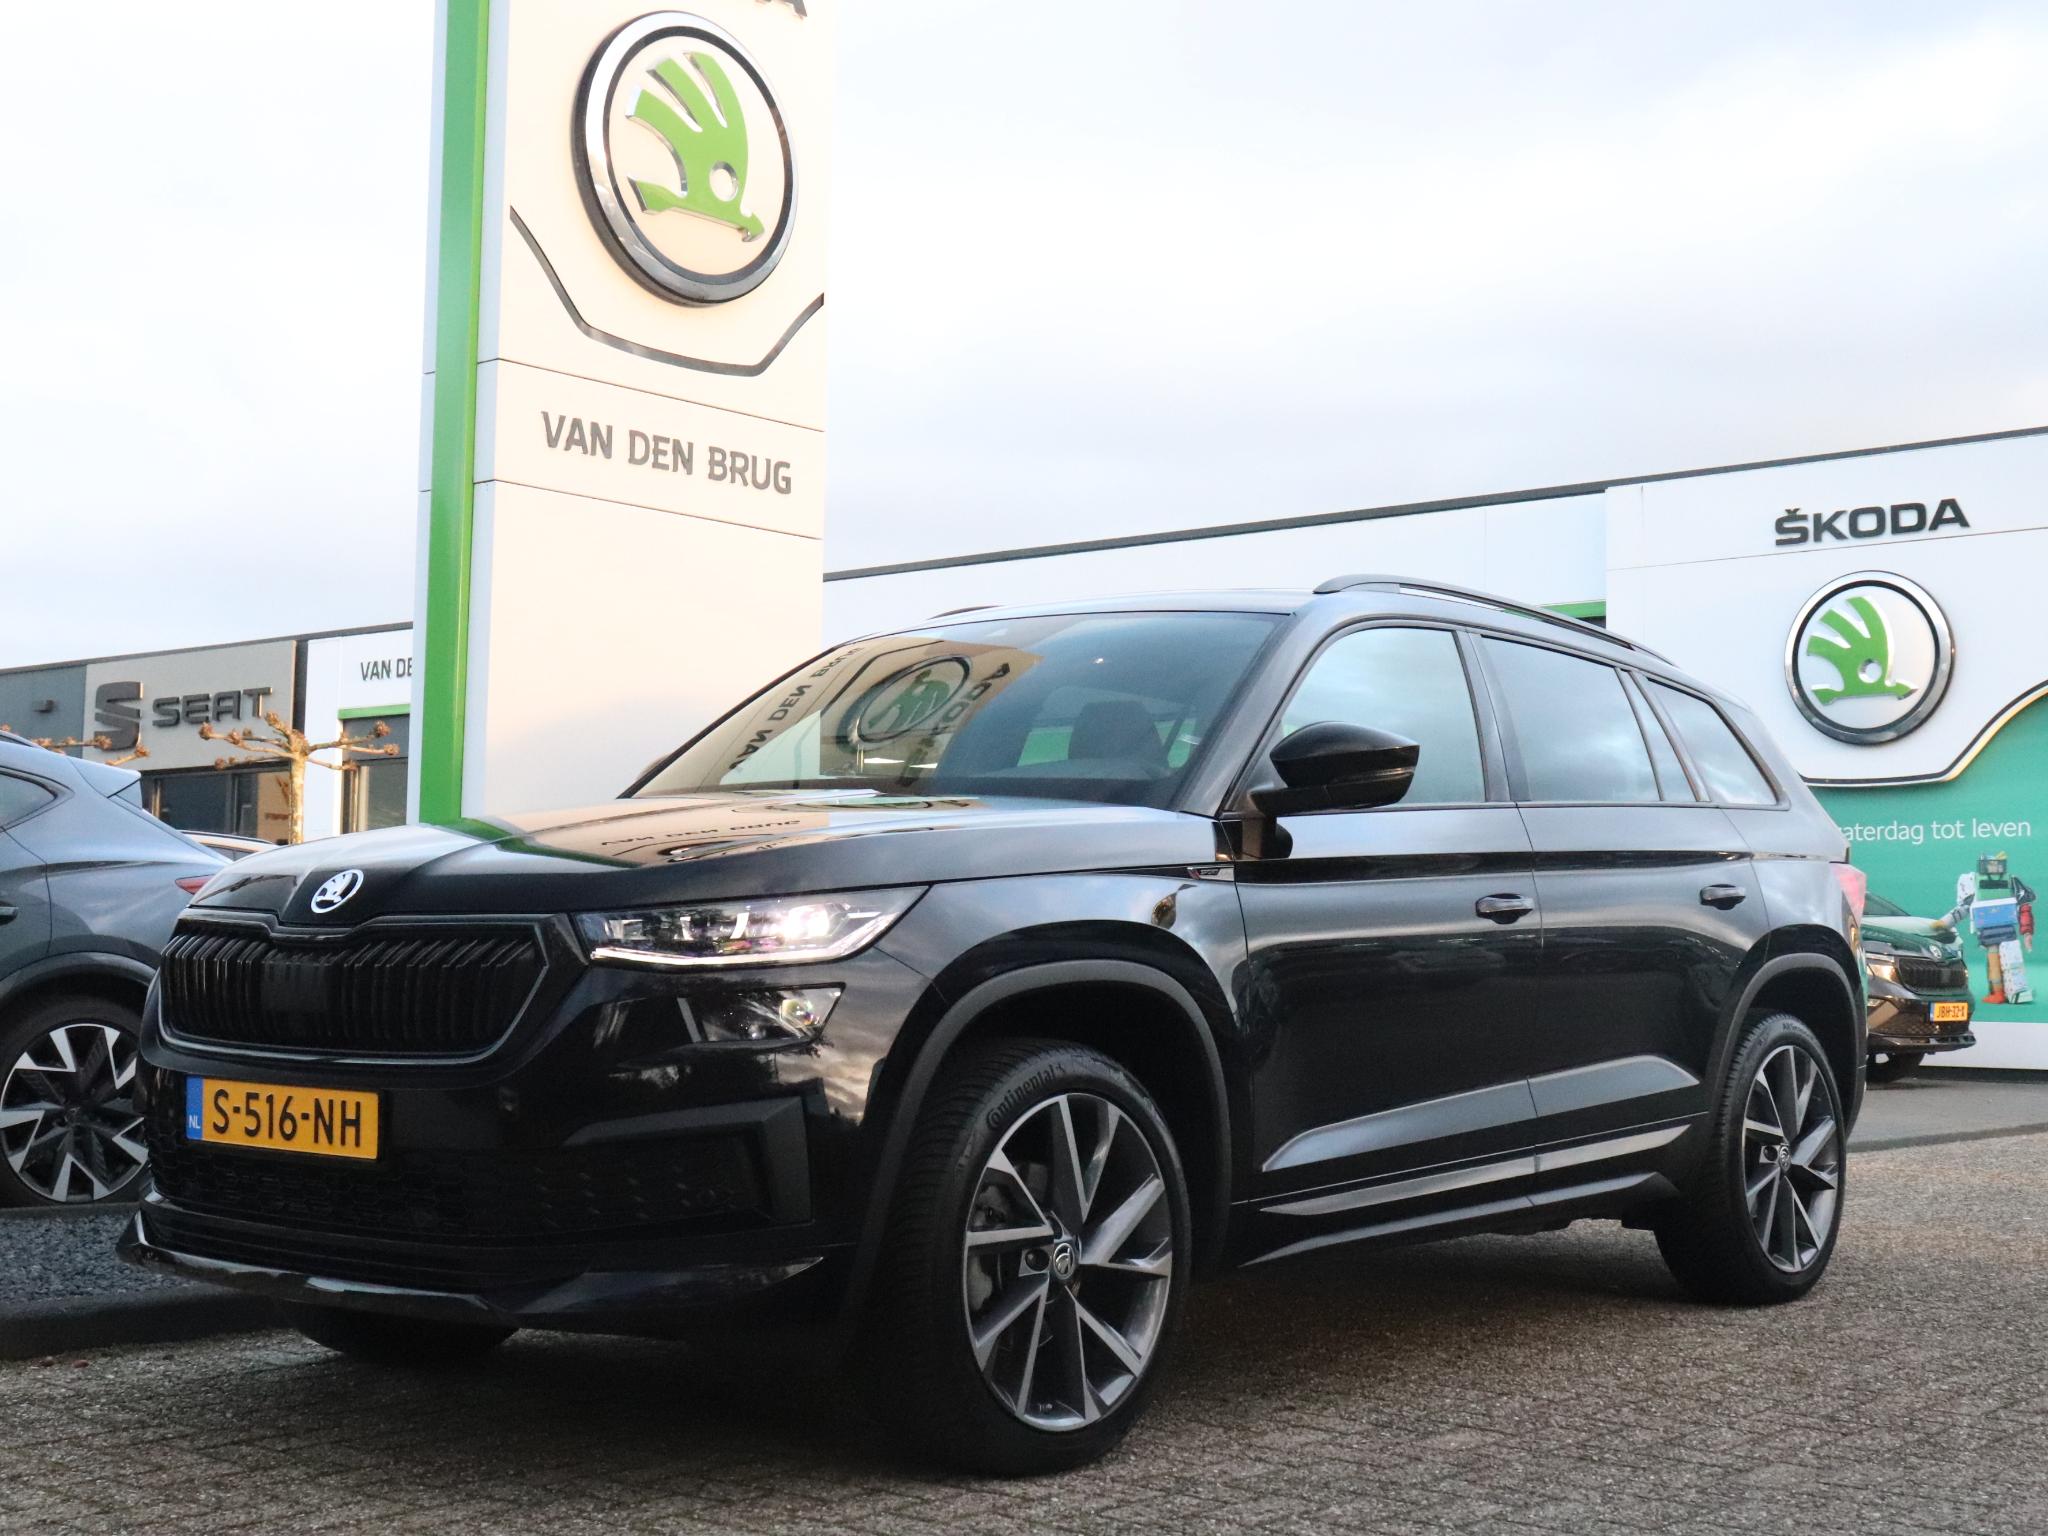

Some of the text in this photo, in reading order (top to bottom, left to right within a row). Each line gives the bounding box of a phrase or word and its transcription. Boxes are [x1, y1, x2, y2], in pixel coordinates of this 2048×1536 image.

[541, 409, 792, 495] VAN DEN BRUG
[1775, 498, 1970, 546] ŠKODA
[360, 657, 413, 681] VAN DE
[152, 687, 273, 727] SEAT
[1840, 818, 2032, 845] aterdag tot leven
[188, 1114, 202, 1129] NL
[213, 1088, 361, 1147] S-516-NH
